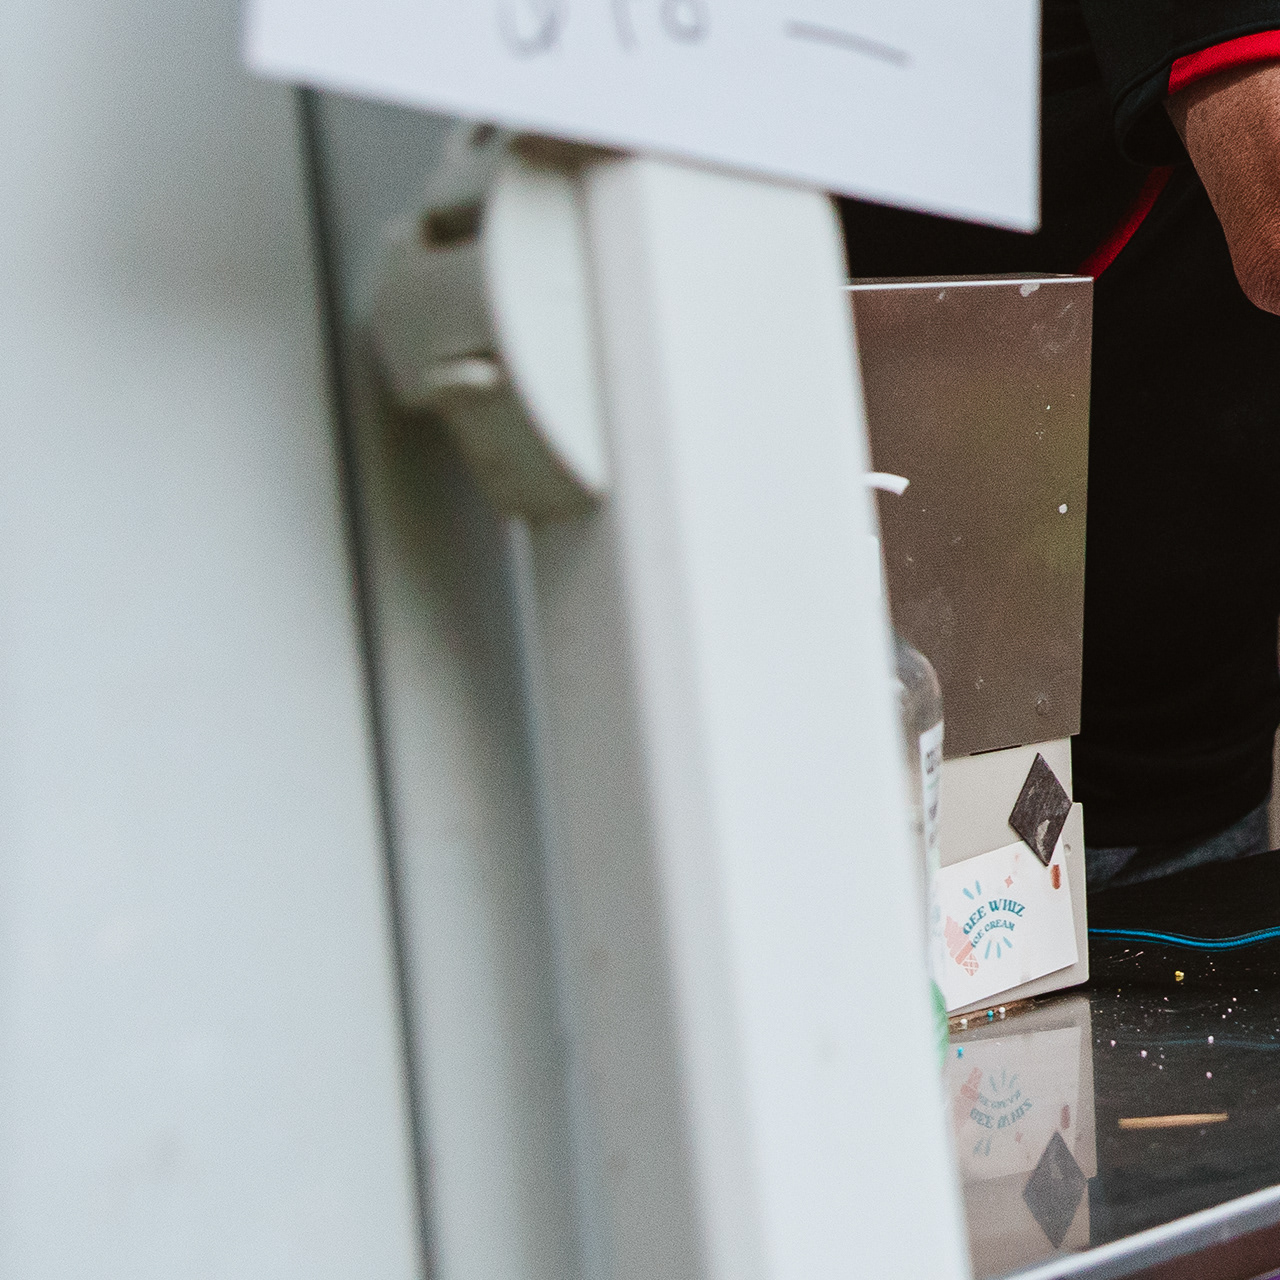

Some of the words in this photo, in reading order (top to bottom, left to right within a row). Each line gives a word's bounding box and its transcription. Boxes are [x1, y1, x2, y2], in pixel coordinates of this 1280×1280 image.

[963, 905, 987, 935] GEE
[988, 898, 1026, 918] WHIZ
[984, 919, 1015, 933] CREAM
